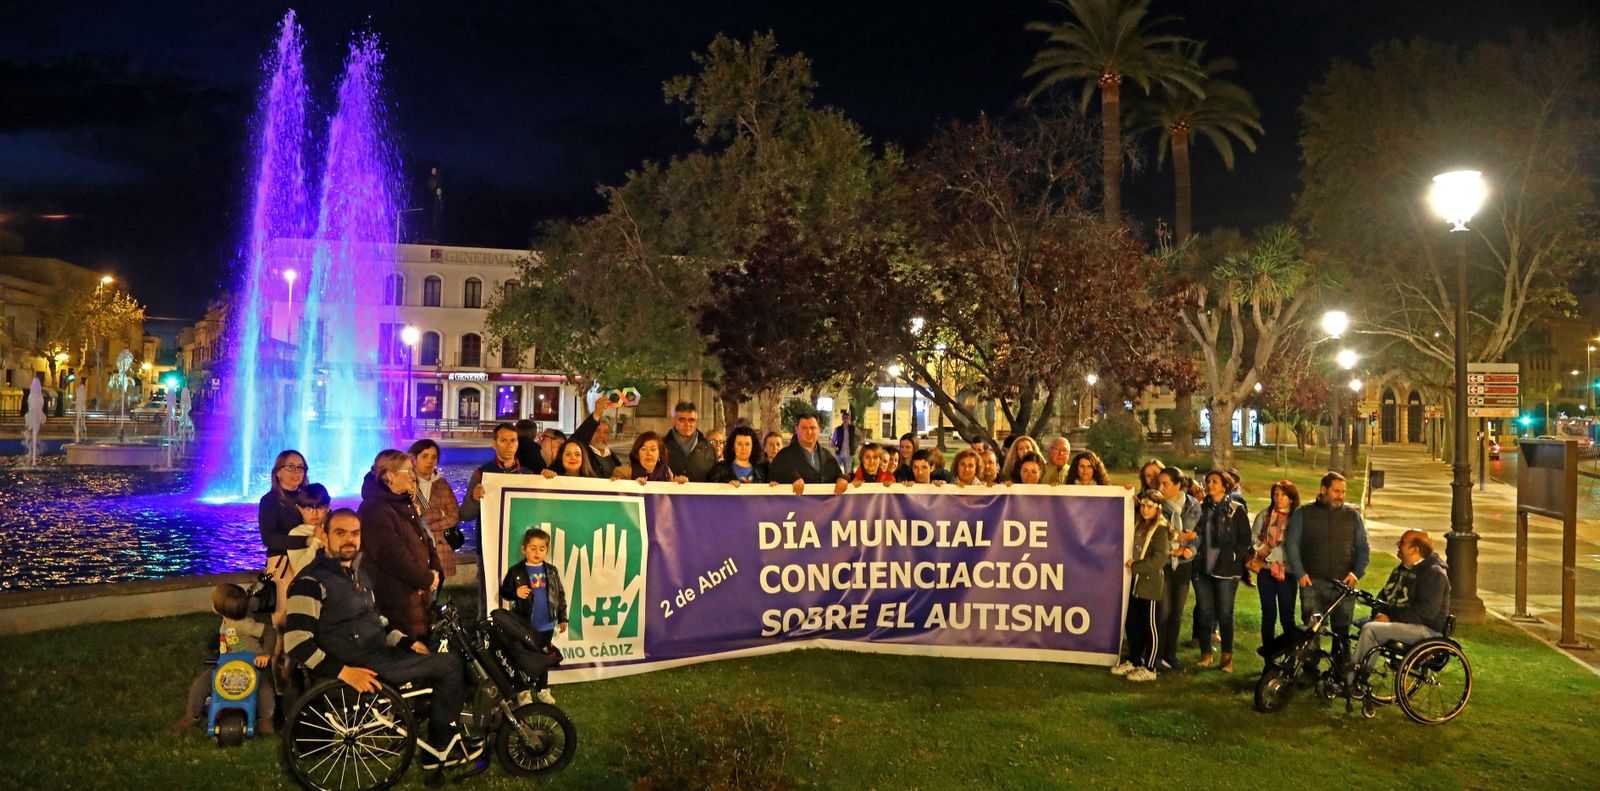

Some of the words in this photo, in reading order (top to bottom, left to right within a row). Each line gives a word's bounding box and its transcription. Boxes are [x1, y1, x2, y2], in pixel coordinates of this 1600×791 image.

[758, 512, 821, 550] DÍA
[831, 519, 991, 548] MUNDIAL
[1003, 521, 1048, 548] DE
[660, 600, 674, 618] 2
[675, 589, 696, 608] de
[698, 557, 738, 594] Abril
[759, 554, 1064, 594] CONCIENCIACIÓN
[761, 604, 869, 637] SOBRE
[876, 602, 915, 629] EL
[924, 603, 1090, 635] AUTISMO
[589, 642, 634, 657] CÁDIZ
